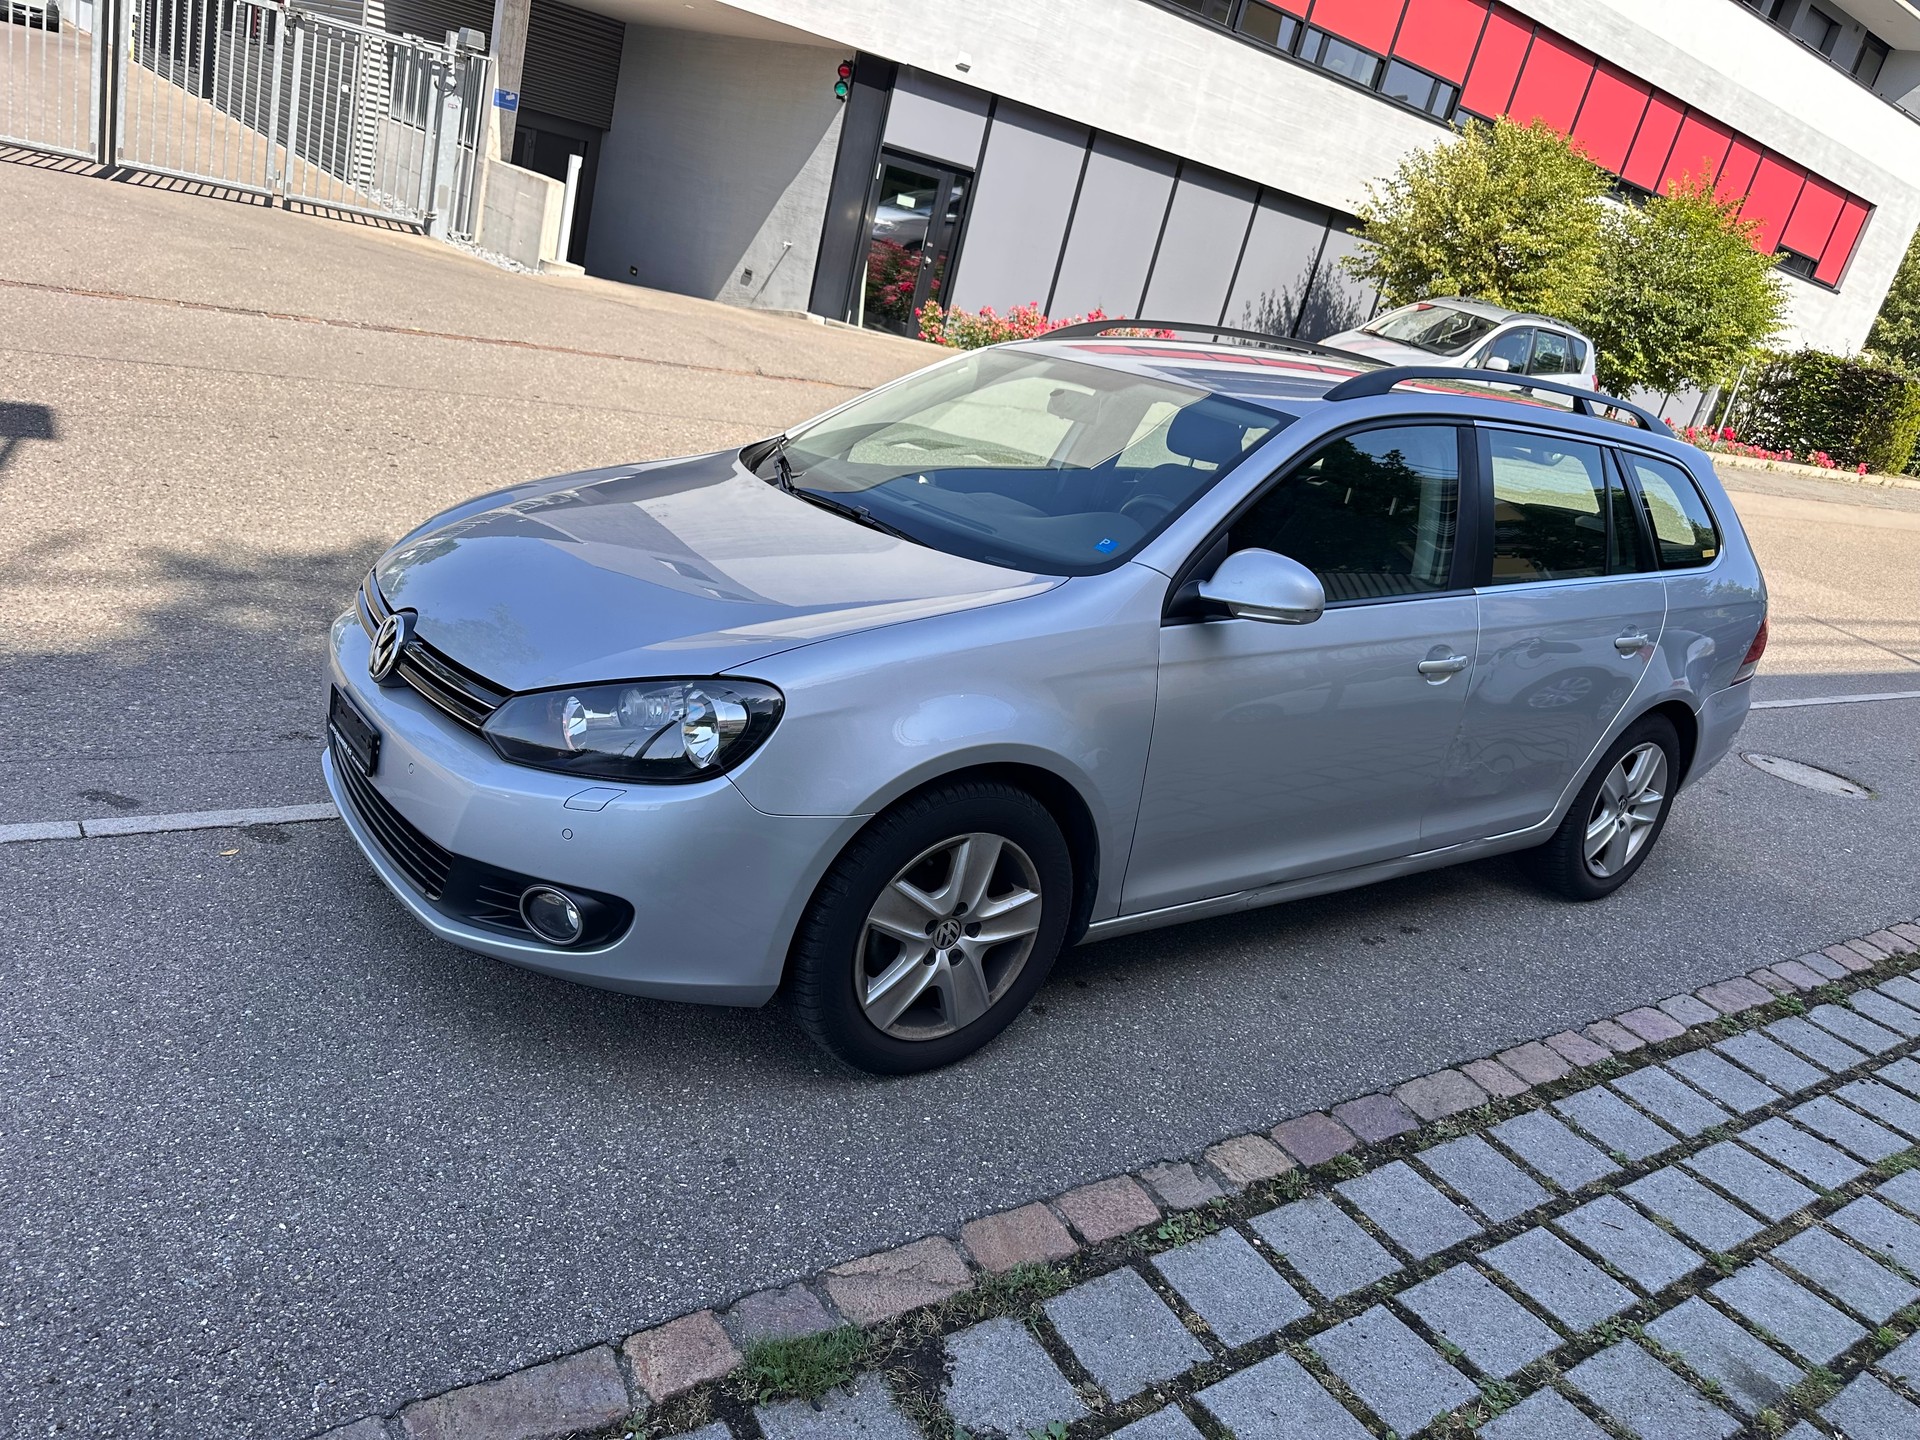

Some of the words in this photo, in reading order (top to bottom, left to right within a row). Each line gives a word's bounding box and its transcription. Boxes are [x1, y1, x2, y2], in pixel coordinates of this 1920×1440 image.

[1099, 538, 1111, 546] P
[369, 615, 404, 682] VW
[934, 919, 961, 949] VW
